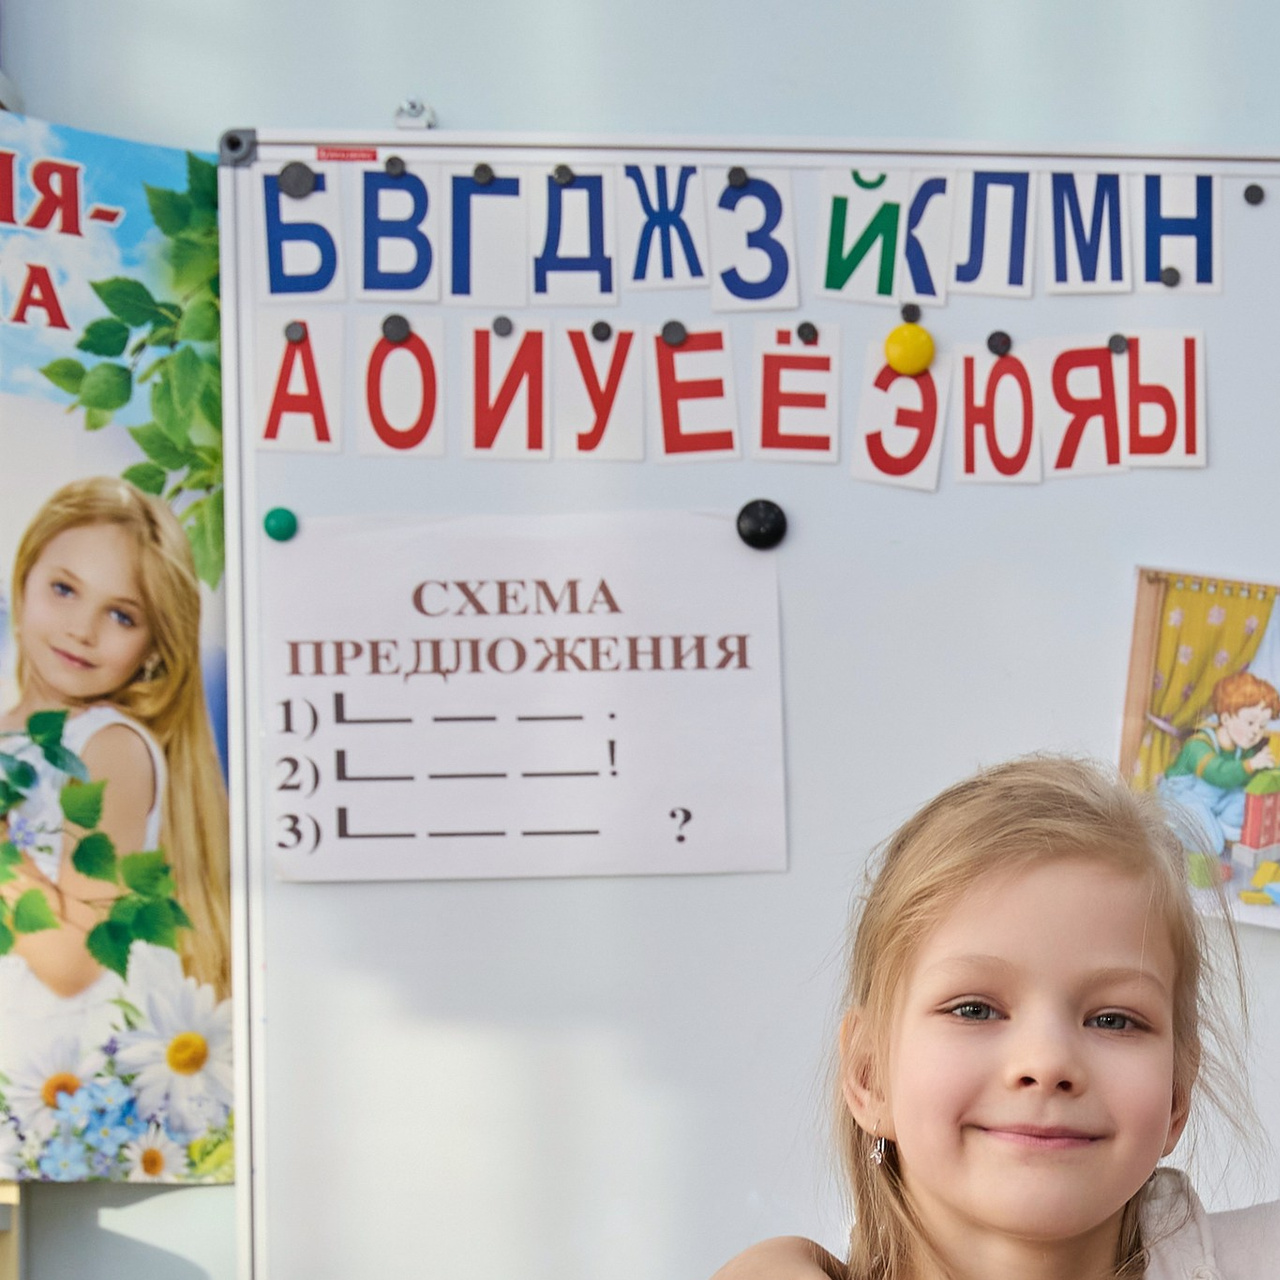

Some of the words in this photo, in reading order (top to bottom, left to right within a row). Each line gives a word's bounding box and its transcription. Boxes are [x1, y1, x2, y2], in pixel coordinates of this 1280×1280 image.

[411, 577, 623, 617] СХЕМА
[286, 634, 751, 682] ПРЕДЛОЖЕНИЯ
[276, 699, 318, 737] 1)
[276, 756, 320, 796] 2)
[276, 813, 322, 854] 3)
